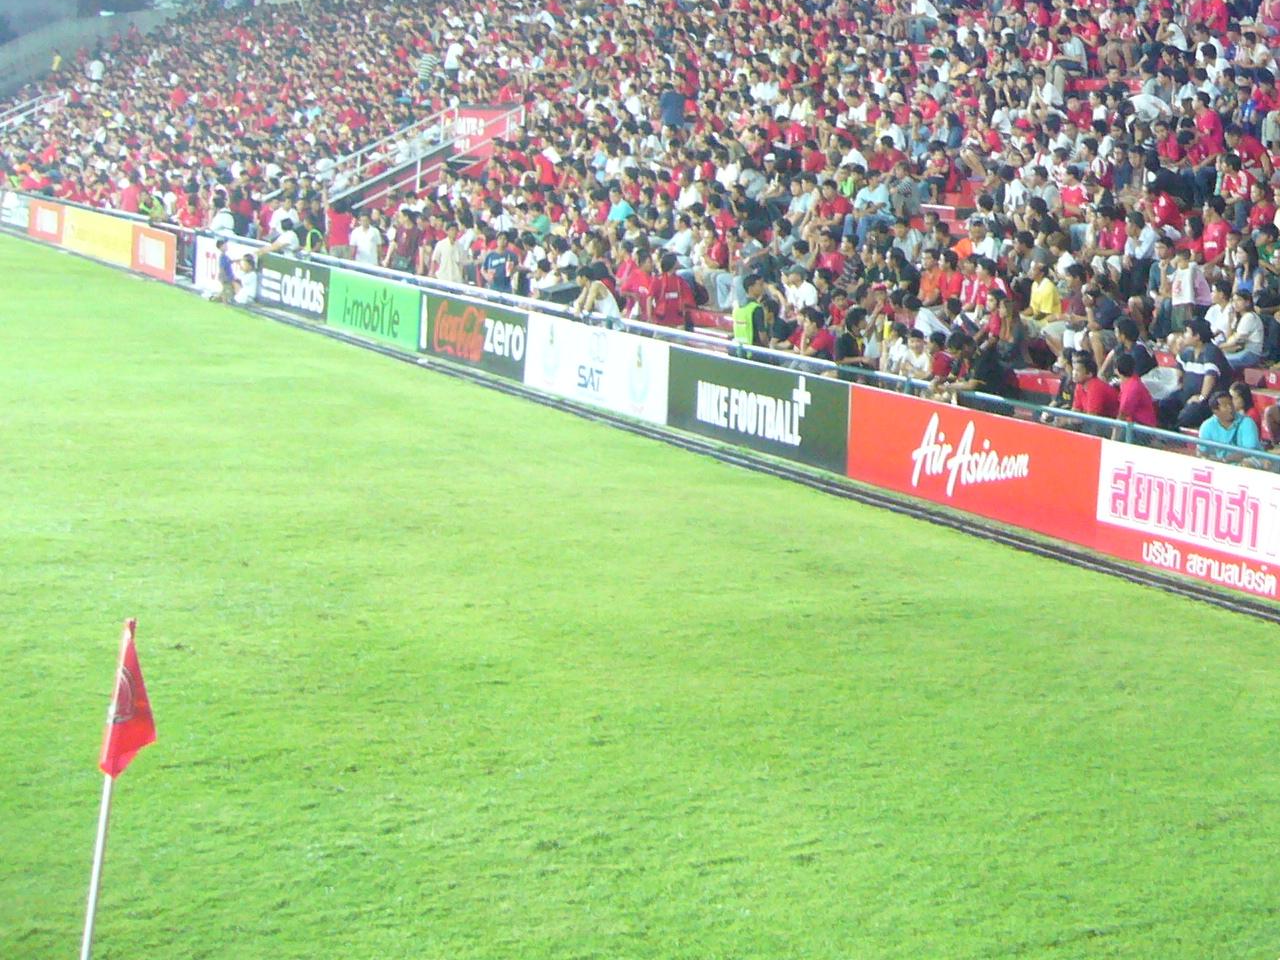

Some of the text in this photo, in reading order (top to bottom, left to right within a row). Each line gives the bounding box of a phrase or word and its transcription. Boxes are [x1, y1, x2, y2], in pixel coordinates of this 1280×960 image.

[281, 267, 325, 314] adidas
[342, 286, 400, 338] i-mobile
[484, 318, 526, 361] zero
[696, 380, 729, 428] NIKE
[1142, 540, 1181, 569] บริษัท
